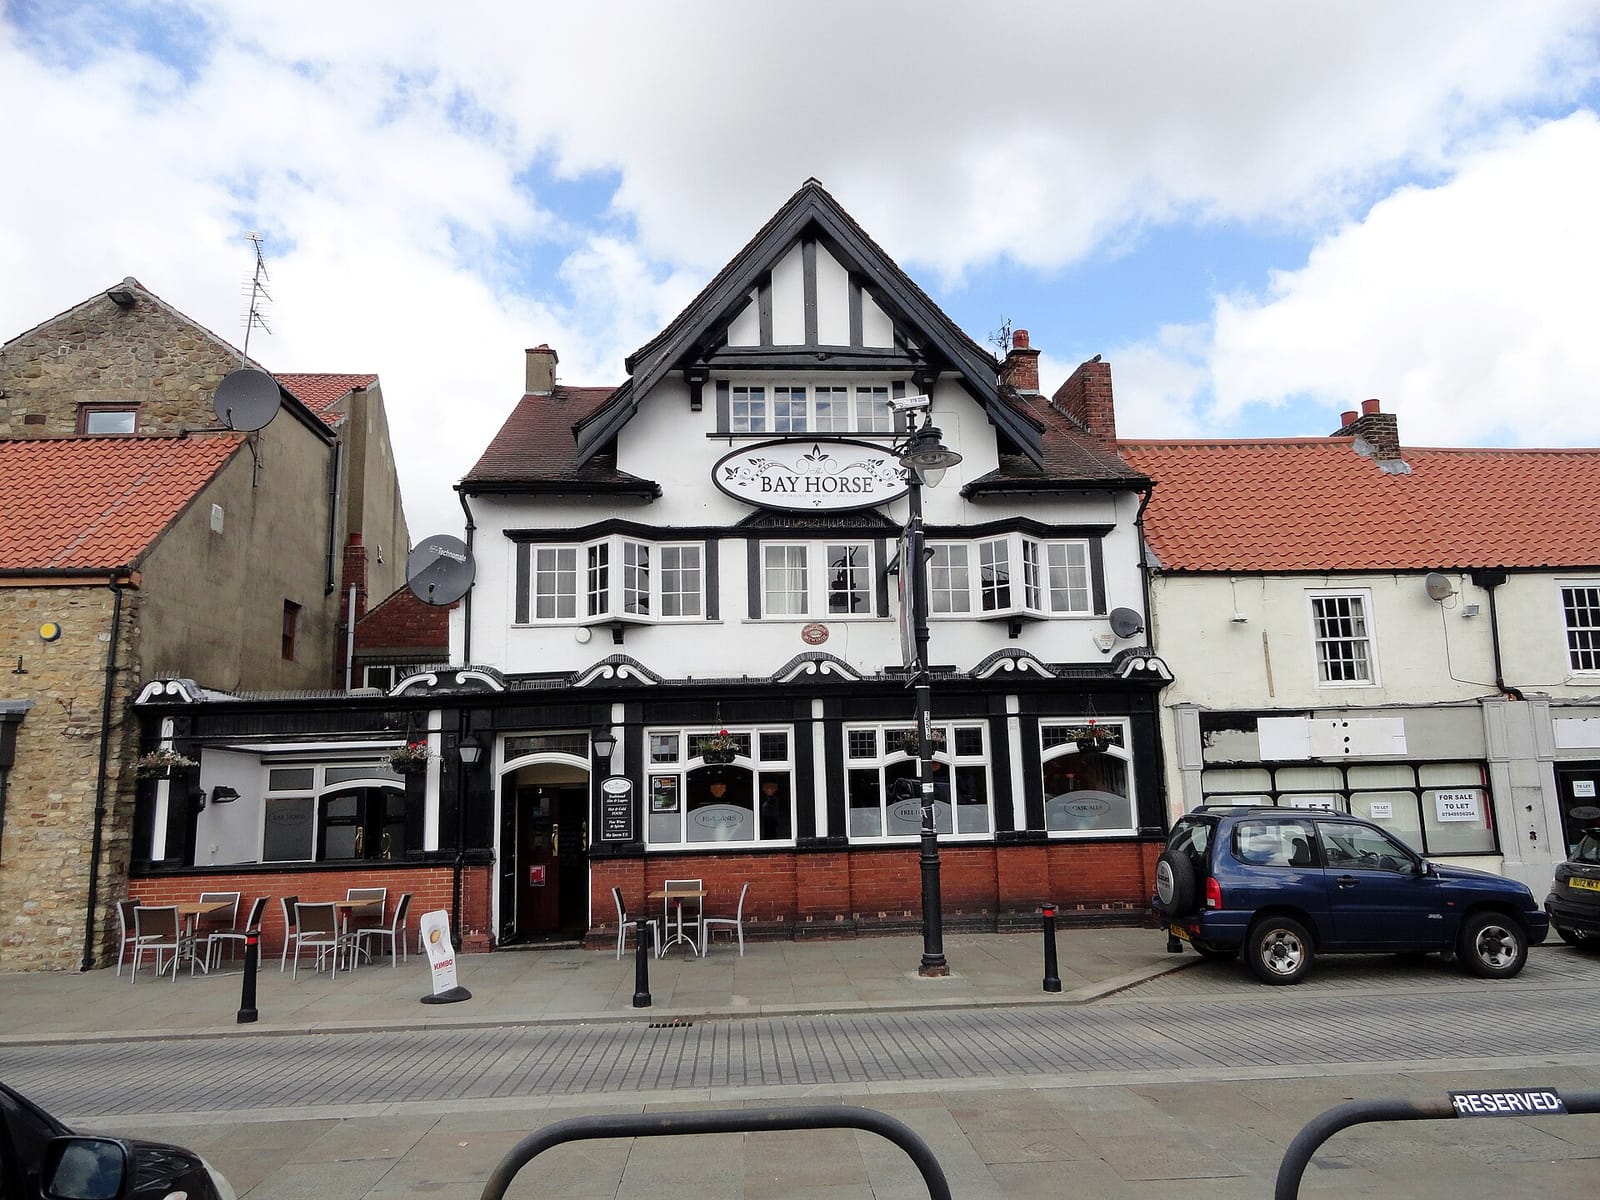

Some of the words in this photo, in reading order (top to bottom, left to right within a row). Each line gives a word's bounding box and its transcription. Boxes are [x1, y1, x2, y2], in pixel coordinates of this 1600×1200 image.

[760, 476, 800, 493] BAY
[805, 476, 873, 493] HORSE
[433, 959, 454, 971] KIMBO
[1453, 1091, 1560, 1113] RESERVED
